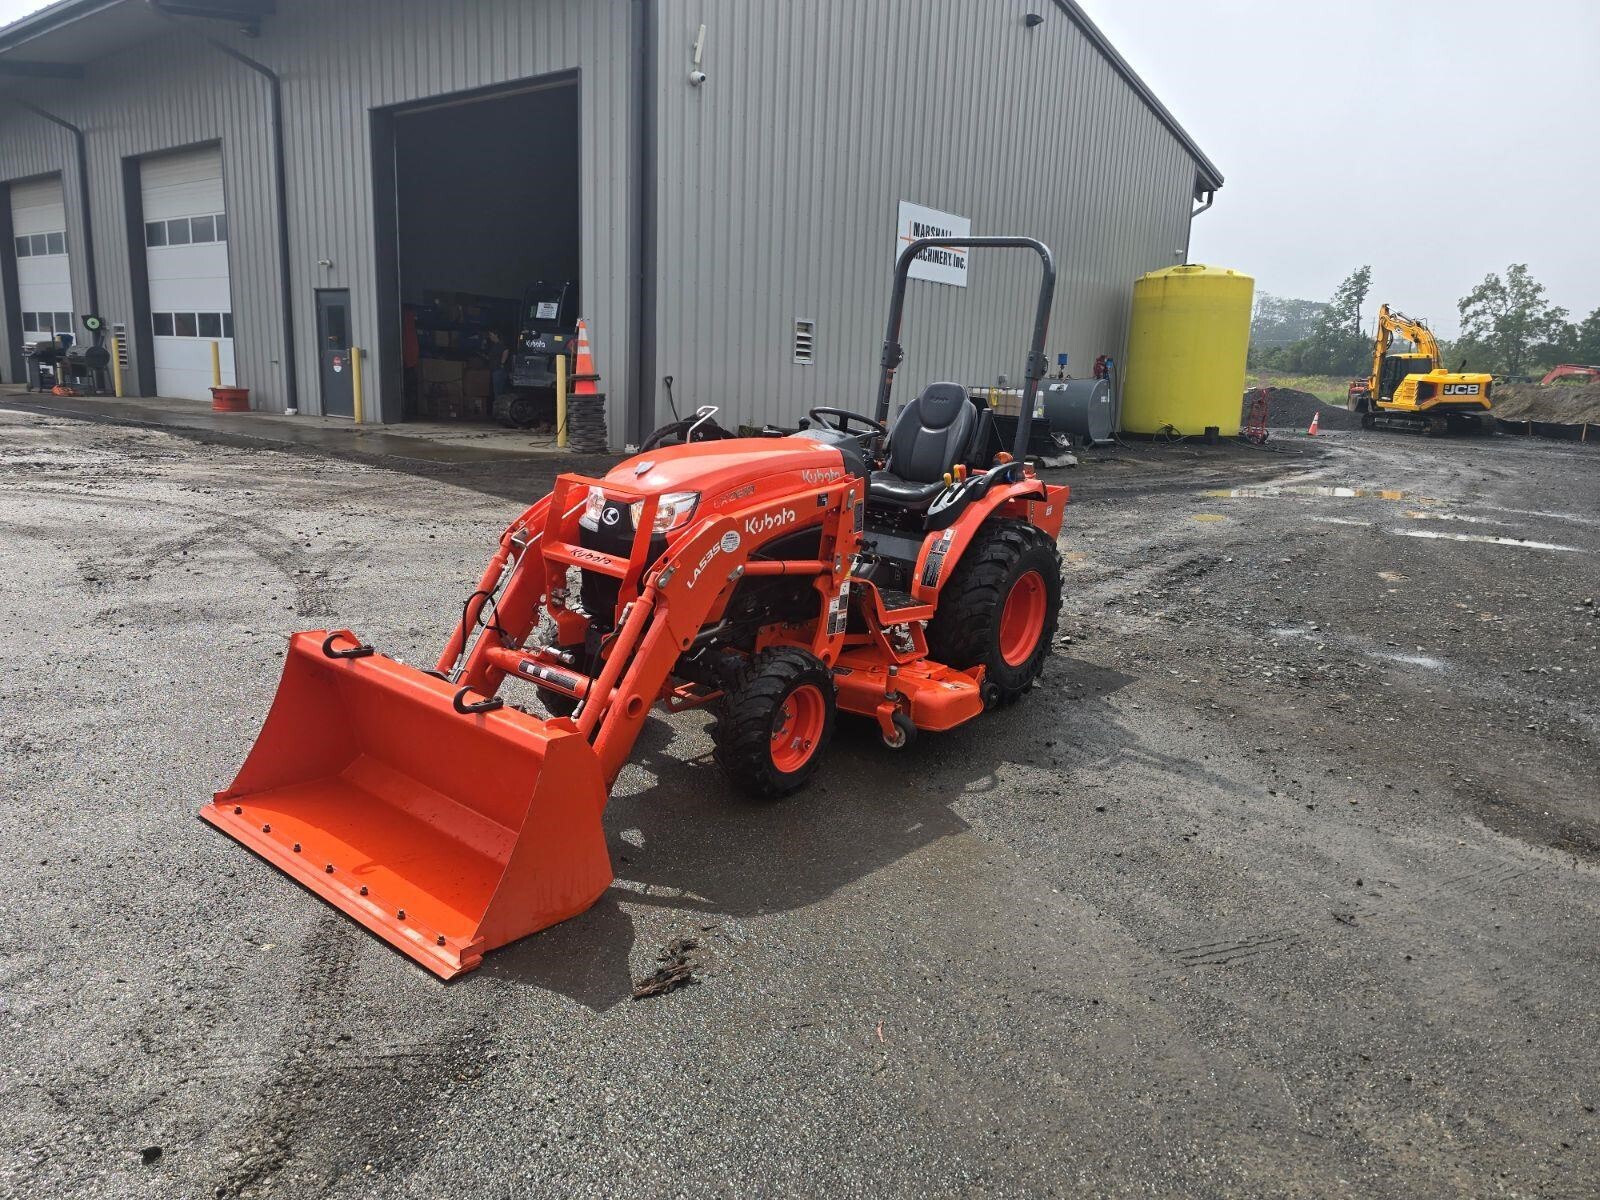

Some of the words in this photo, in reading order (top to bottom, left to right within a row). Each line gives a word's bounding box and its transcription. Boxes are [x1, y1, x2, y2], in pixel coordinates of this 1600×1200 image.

[953, 254, 966, 269] Inc.
[1444, 384, 1479, 395] JCB
[802, 468, 840, 485] Kubota
[745, 507, 796, 535] Kubota
[570, 548, 612, 565] Kubota
[686, 542, 722, 589] LA535
